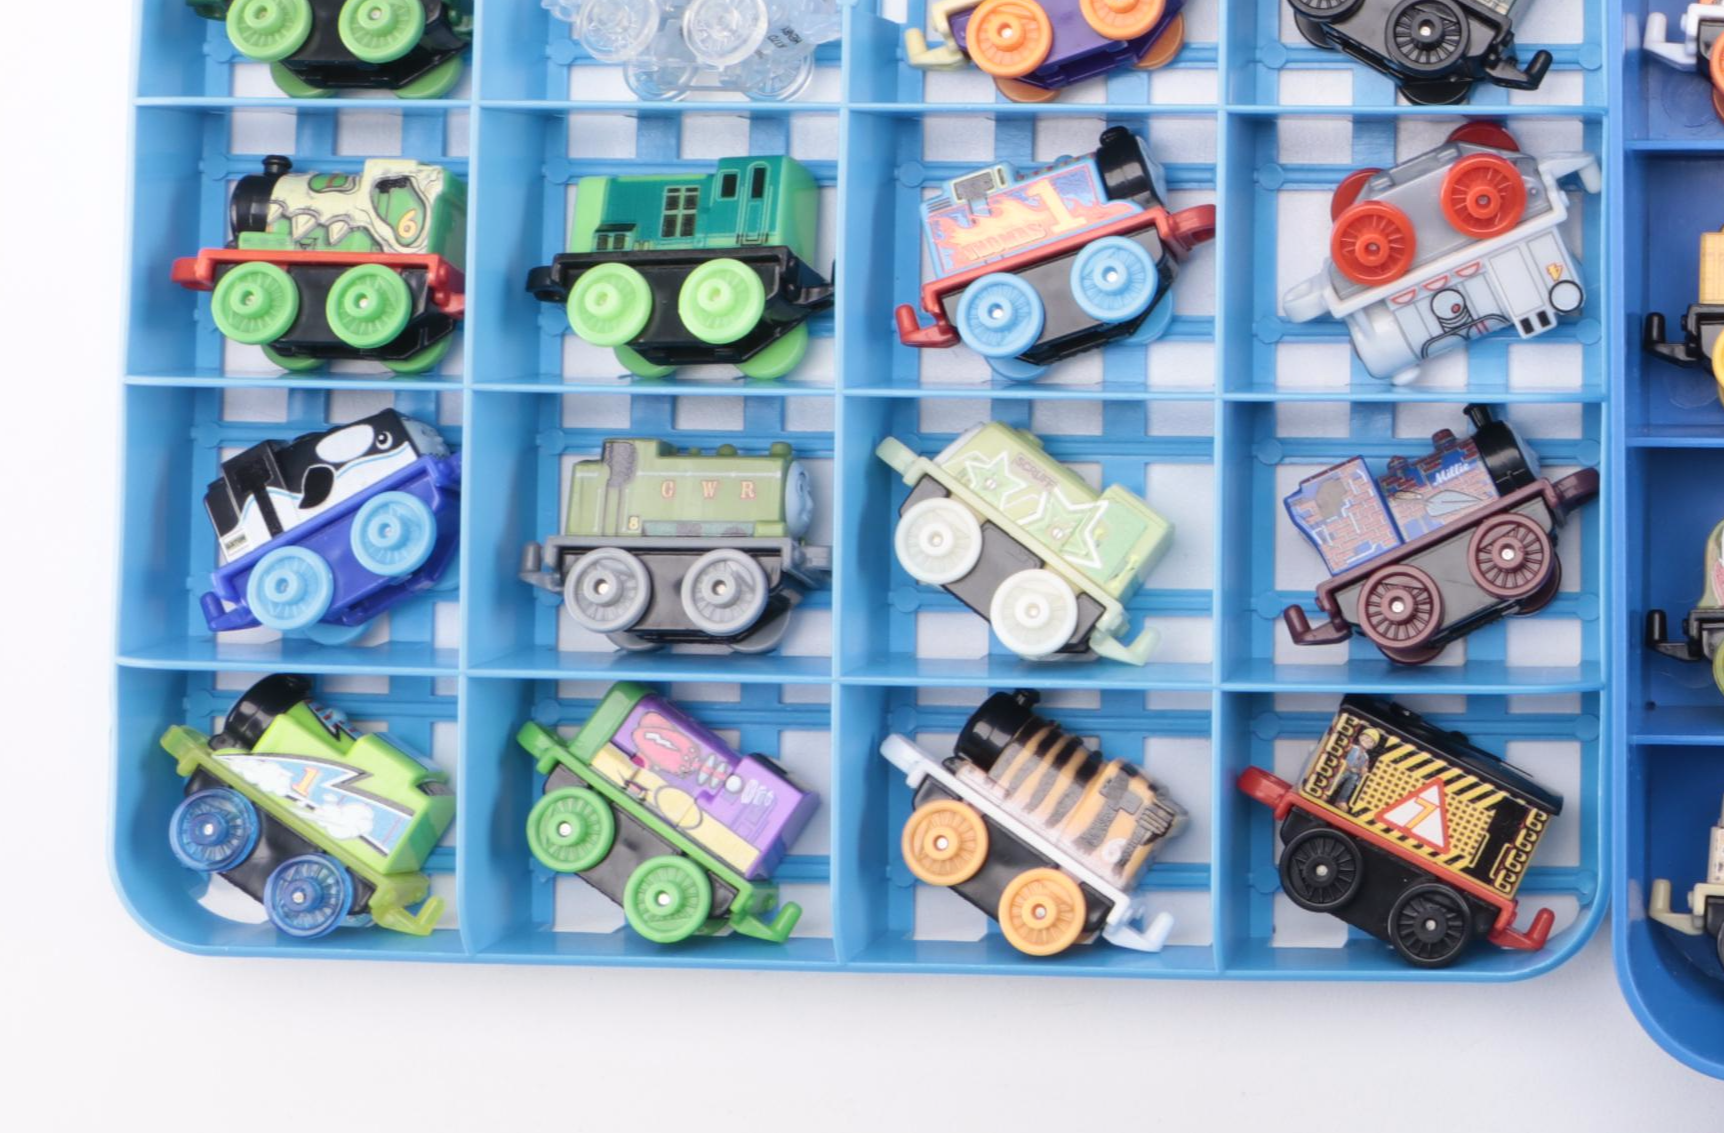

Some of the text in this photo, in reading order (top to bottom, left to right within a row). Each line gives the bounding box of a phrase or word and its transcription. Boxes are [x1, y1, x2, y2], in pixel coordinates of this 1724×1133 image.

[1026, 178, 1088, 234] 1
[397, 207, 418, 239] 6
[660, 479, 757, 500] G W R
[1432, 461, 1470, 487] Millie
[627, 515, 640, 531] 8
[291, 766, 319, 798] 1
[1403, 795, 1441, 831] 7
